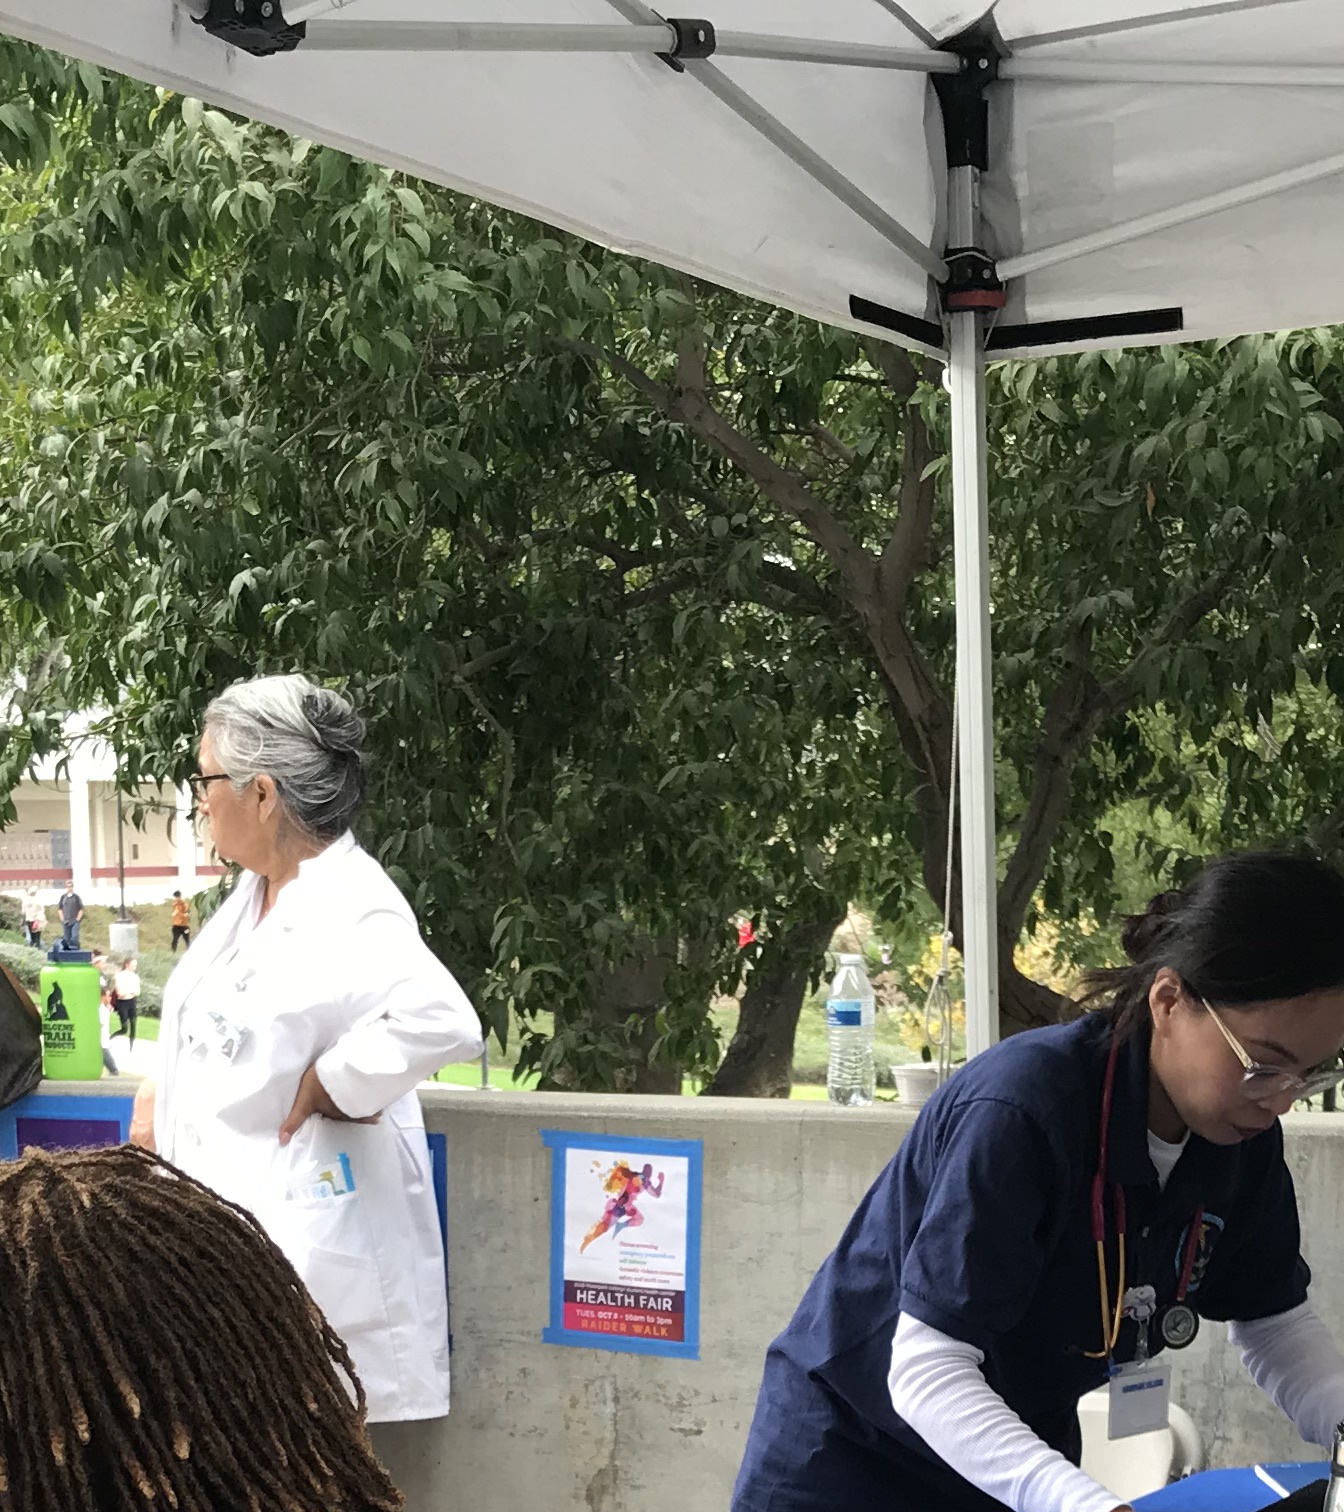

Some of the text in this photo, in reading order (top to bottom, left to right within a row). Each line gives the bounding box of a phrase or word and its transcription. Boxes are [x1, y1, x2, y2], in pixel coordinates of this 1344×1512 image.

[576, 1289, 635, 1307] HEALTH
[639, 1295, 673, 1311] FAIR
[581, 1318, 668, 1337] RAIDER WALK
[646, 1315, 655, 1323] to
